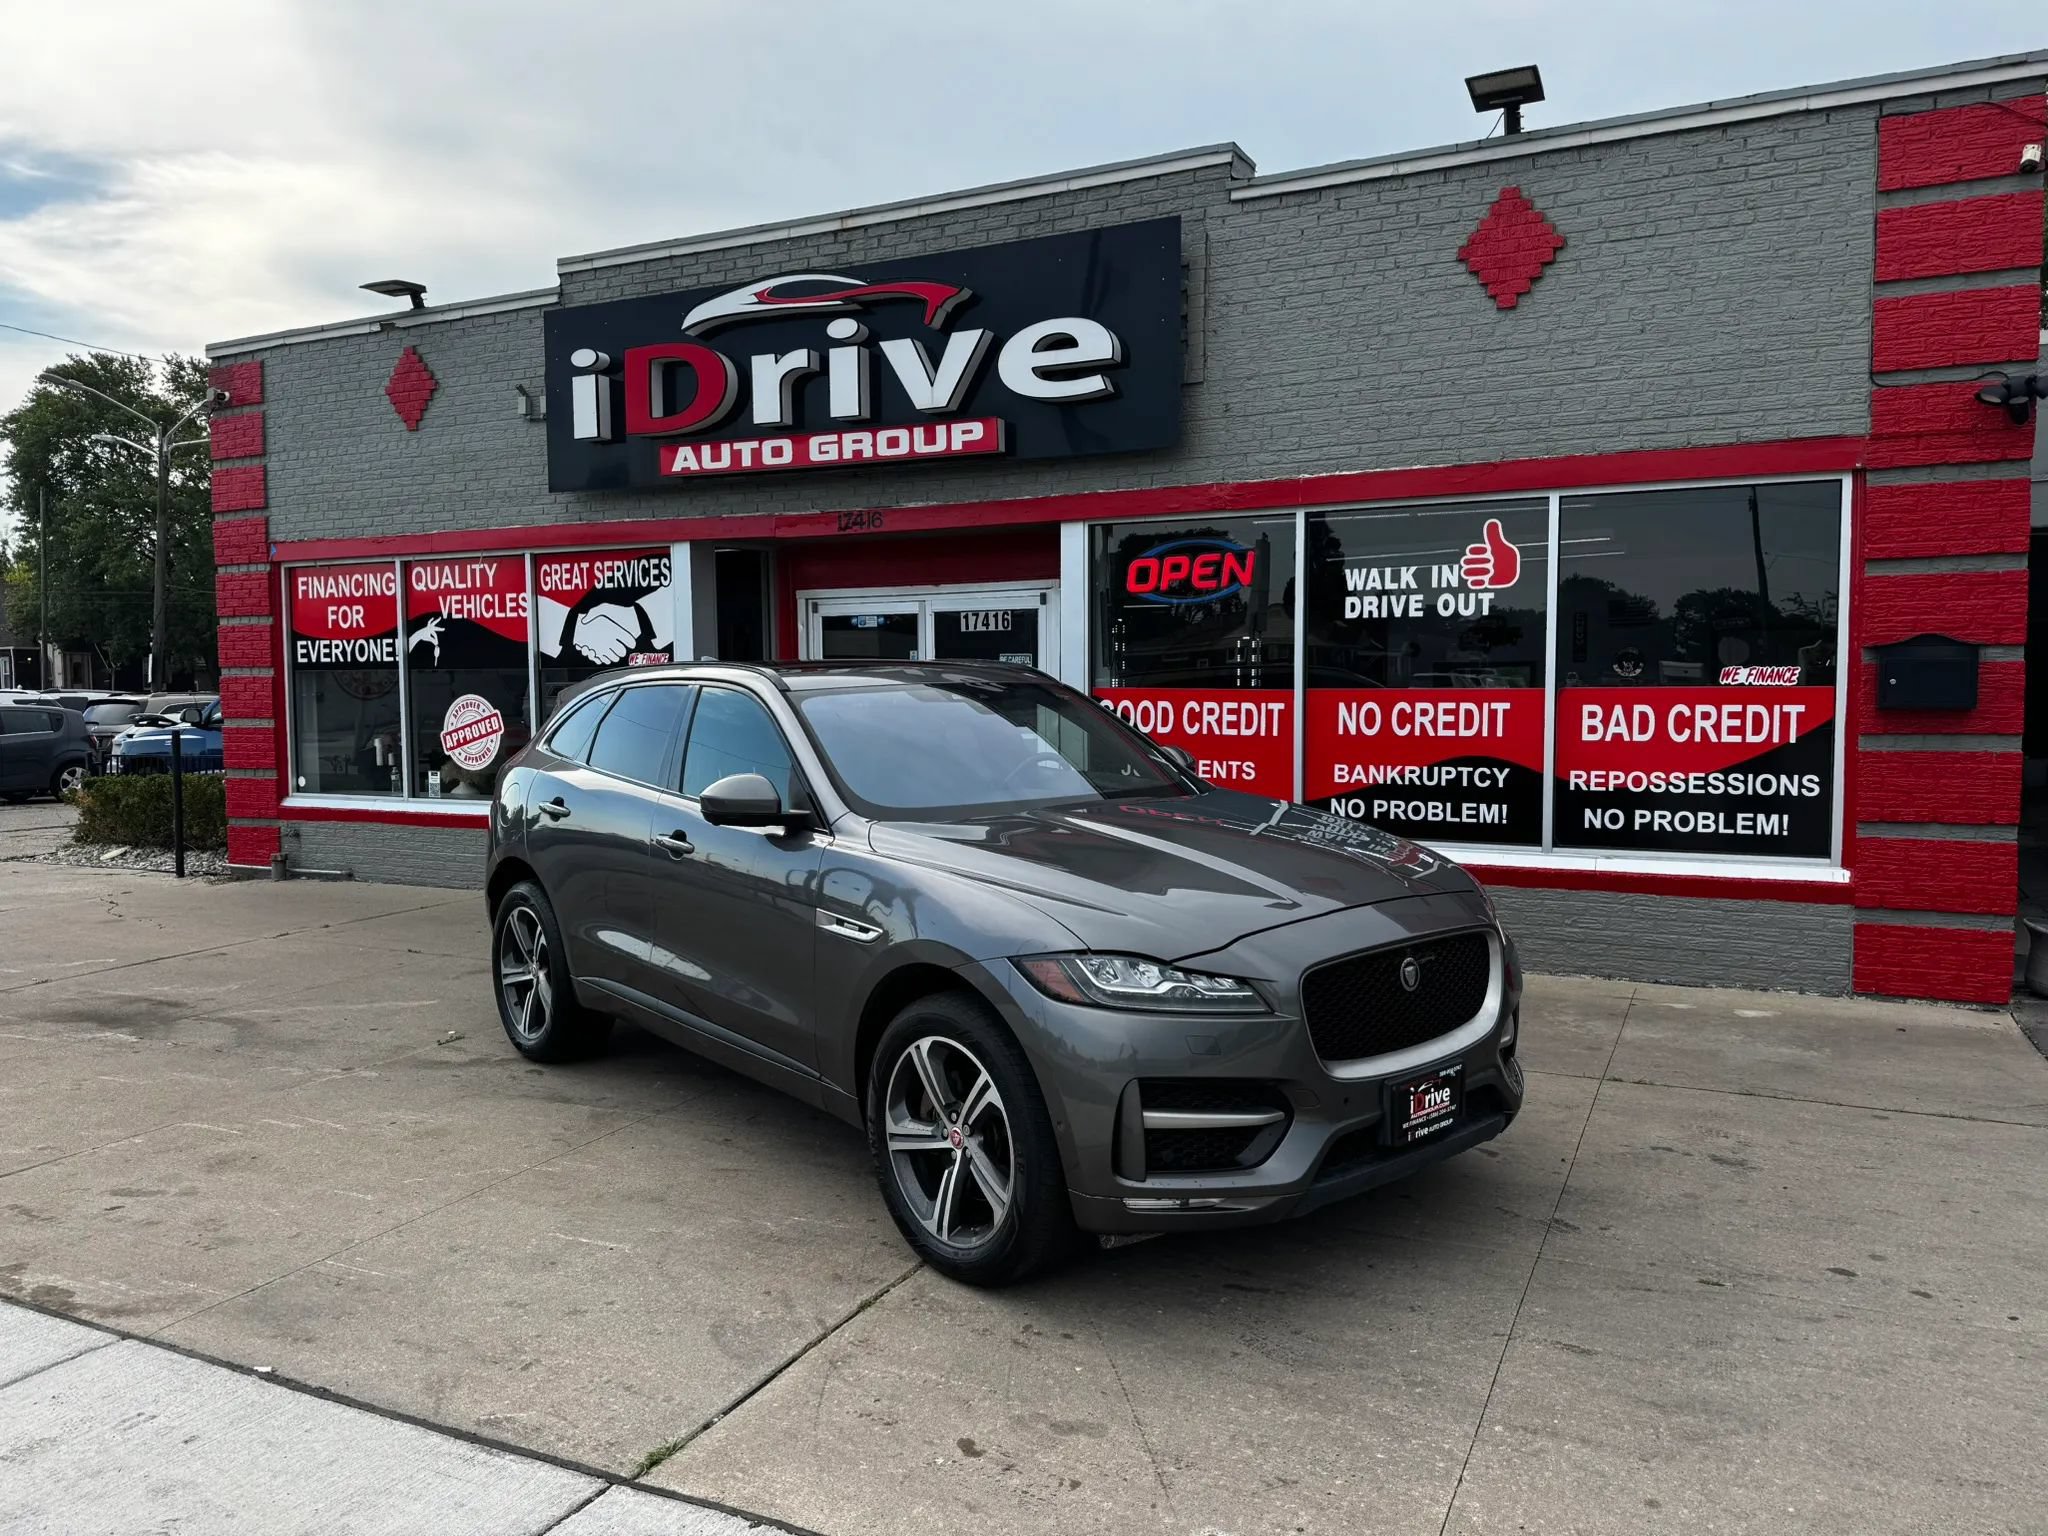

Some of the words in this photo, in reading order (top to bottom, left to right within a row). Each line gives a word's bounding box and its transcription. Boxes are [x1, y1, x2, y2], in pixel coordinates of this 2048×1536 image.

[570, 316, 1121, 441] iDrive
[671, 433, 793, 473] AUTO
[808, 421, 984, 463] GROUP
[412, 563, 497, 591] QUALITY
[540, 562, 589, 592] GREAT
[593, 558, 671, 588] SERVICES
[1126, 550, 1256, 593] OPEN
[1345, 565, 1416, 591] WALK
[1431, 564, 1459, 588] IN
[297, 572, 396, 599] FINANCING
[327, 606, 364, 629] FOR
[438, 594, 529, 619] VEHICLES
[1345, 593, 1424, 619] DRIVE
[1437, 592, 1494, 616] OUT
[962, 612, 1010, 631] 17416
[1719, 667, 1742, 685] WE
[1745, 667, 1800, 685] FINANCE
[1183, 701, 1285, 736] CREDIT
[1337, 701, 1381, 736] NO
[1391, 702, 1511, 737] CREDIT
[1581, 704, 1655, 742] BAD
[1667, 704, 1805, 744] CREDIT
[445, 716, 500, 749] APPROVED
[1333, 764, 1510, 788] BANKRUPTCY
[1569, 770, 1820, 797] REPOSSESSIONS
[1330, 798, 1366, 818] NO
[1373, 800, 1508, 824] PROBLEM!
[1584, 808, 1625, 829] NO
[1634, 810, 1789, 836] PROBLEM!
[1410, 1087, 1450, 1114] iDrive
[1408, 1126, 1429, 1141] irive
